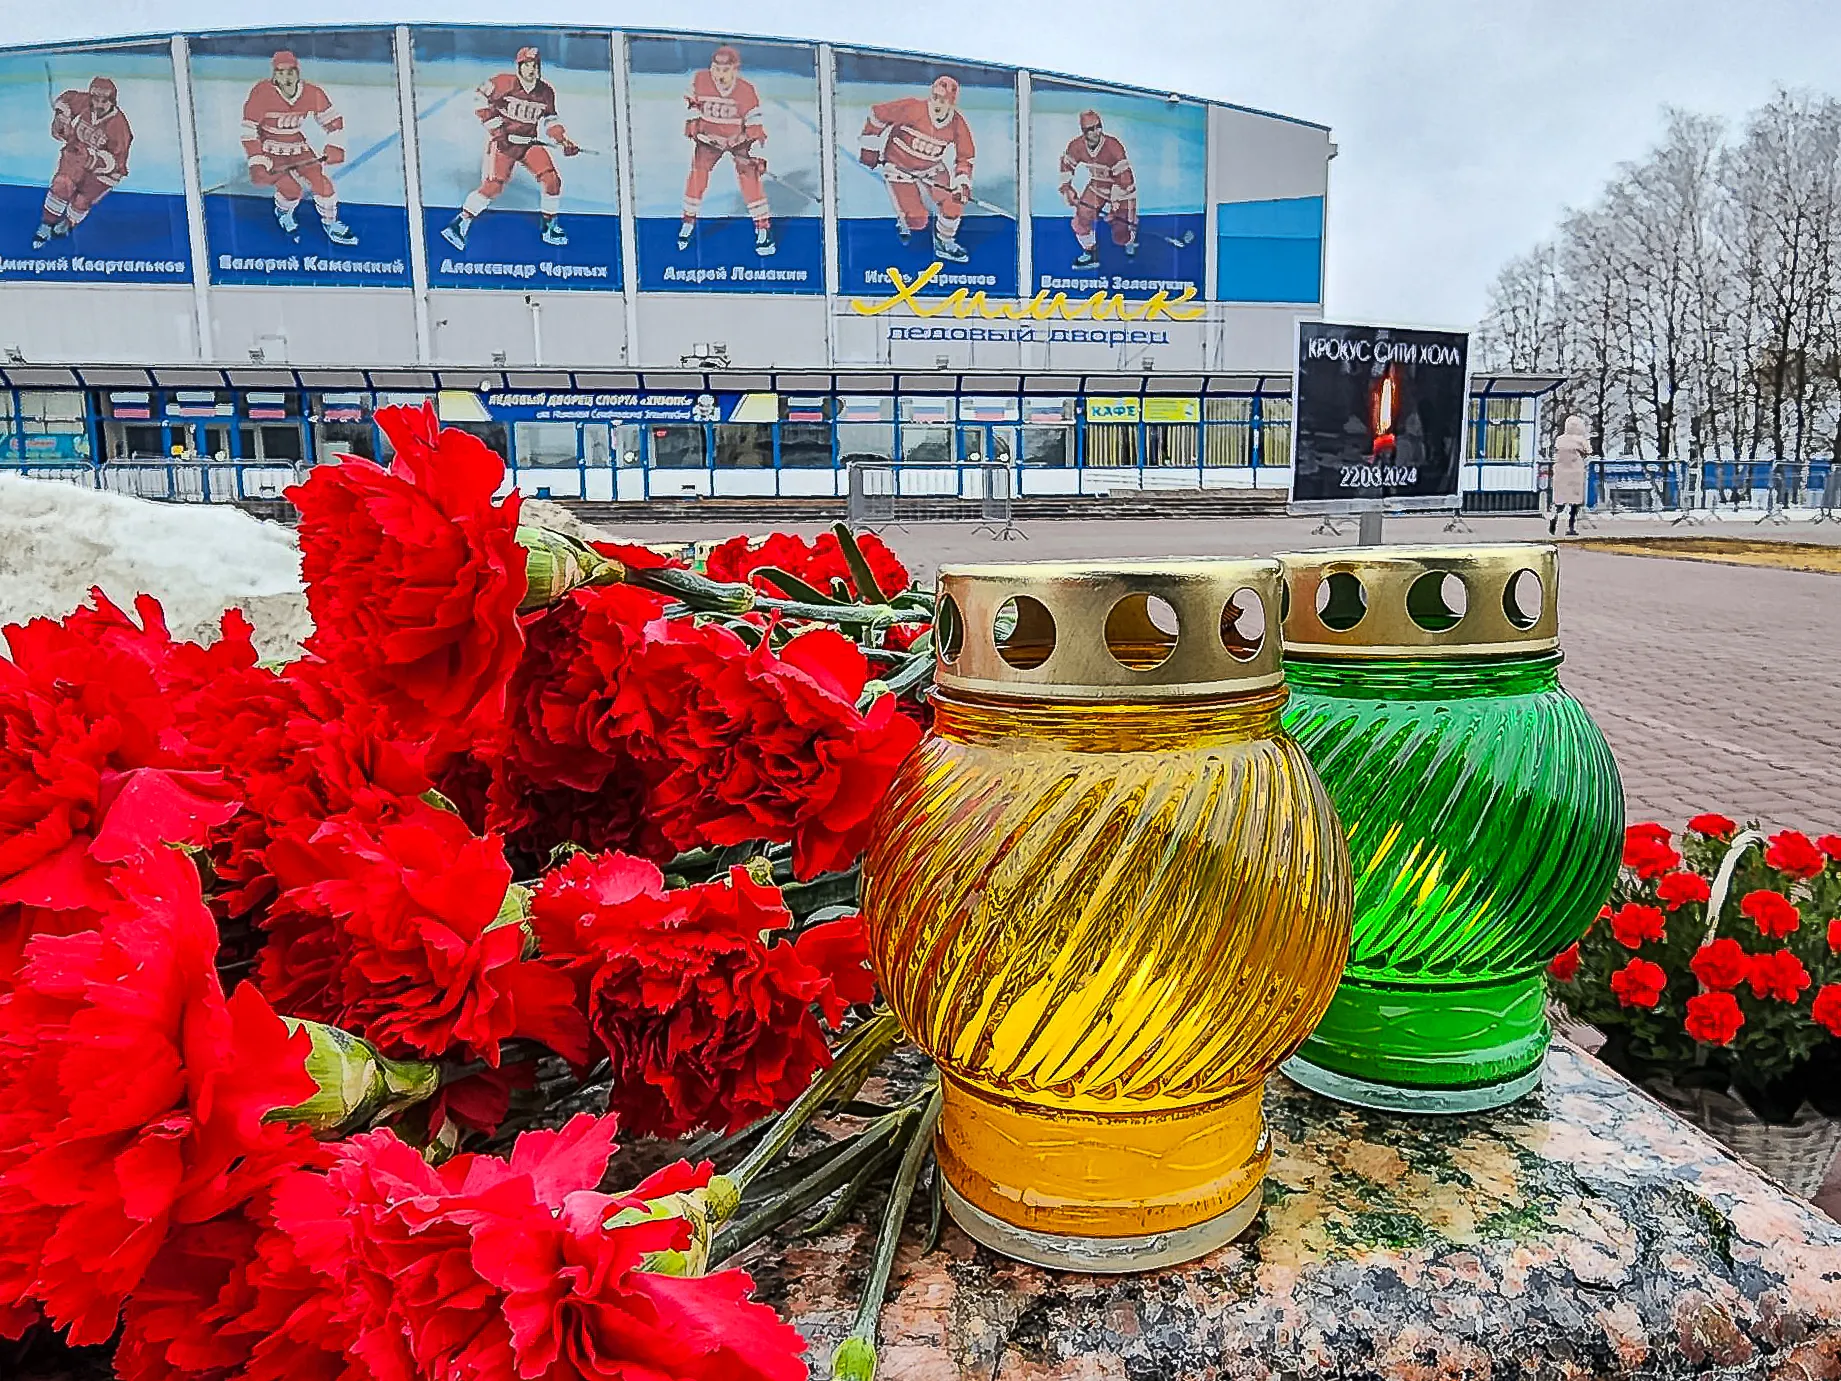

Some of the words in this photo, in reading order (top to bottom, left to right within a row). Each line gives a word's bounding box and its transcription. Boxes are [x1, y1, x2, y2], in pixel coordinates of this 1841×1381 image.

[72, 256, 186, 275] Квартальнов
[219, 255, 300, 273] Валерий
[303, 256, 405, 274] Каменский
[440, 259, 537, 279] Александр
[539, 262, 608, 279] Черных
[664, 266, 727, 284] Андрей
[730, 267, 808, 281] Ломакин
[1041, 275, 1109, 291] Валерий
[851, 262, 1206, 322] Химик
[1050, 328, 1170, 348] дворец
[1308, 337, 1371, 362] КРОКУС
[1374, 340, 1416, 364] СИТИ
[1092, 405, 1137, 417] КАФЕ
